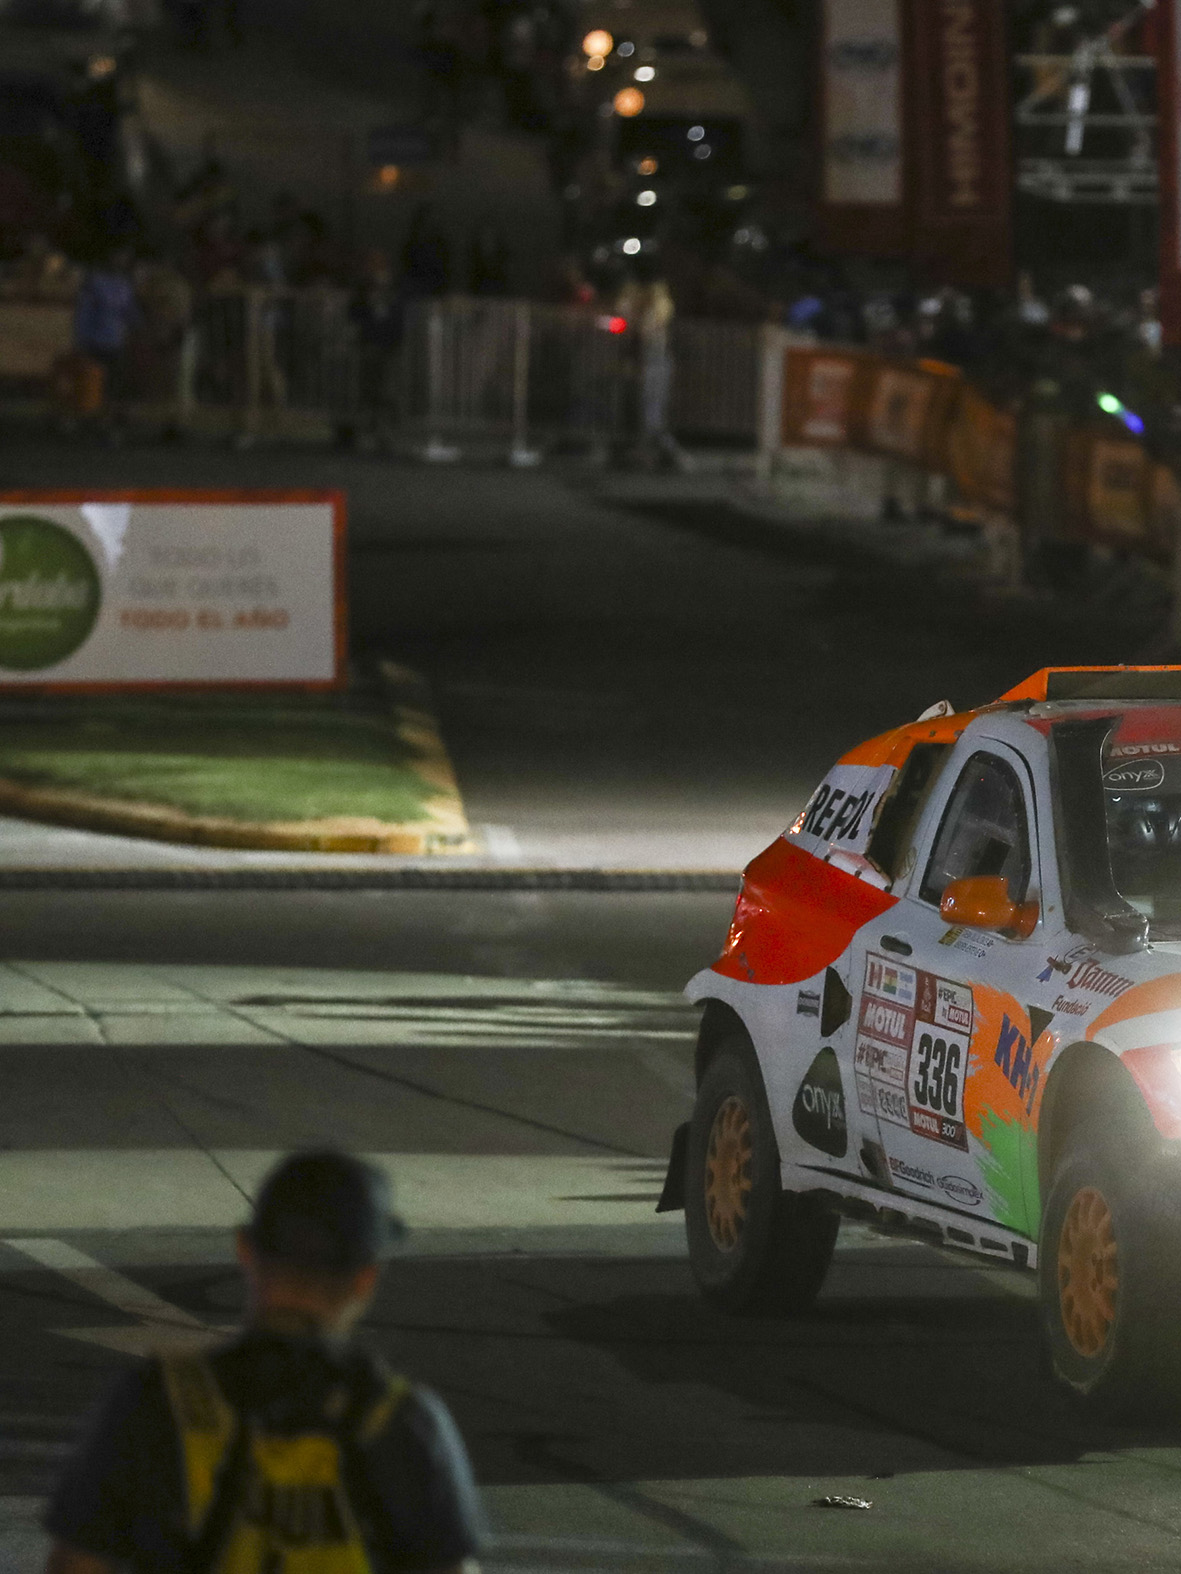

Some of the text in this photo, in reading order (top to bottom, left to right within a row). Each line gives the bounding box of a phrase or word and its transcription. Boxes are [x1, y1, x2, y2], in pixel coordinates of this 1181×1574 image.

[120, 604, 290, 630] TODO EL AÑO
[862, 1002, 906, 1040] MOTUL
[914, 1033, 961, 1117] 336
[802, 1083, 845, 1130] onyx
[912, 1112, 940, 1134] MOTUL
